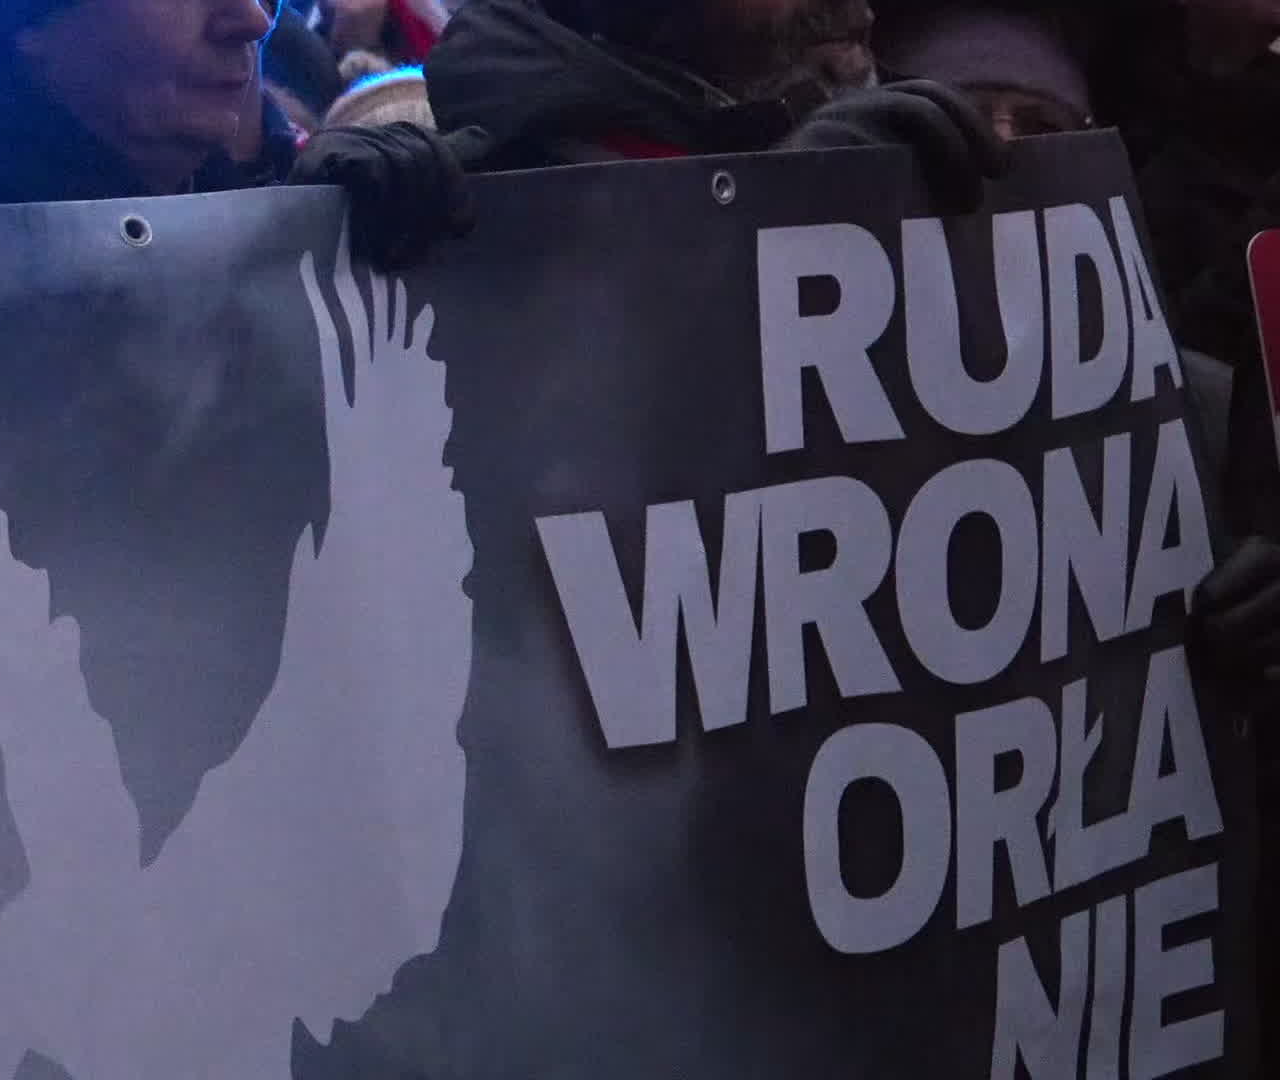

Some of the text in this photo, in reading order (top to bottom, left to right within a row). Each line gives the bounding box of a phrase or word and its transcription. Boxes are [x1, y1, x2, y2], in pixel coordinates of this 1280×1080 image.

[757, 195, 1184, 456] RUDA
[535, 418, 1215, 750] WRONA
[803, 644, 1224, 954] ORŁA
[989, 861, 1225, 1080] NIE
